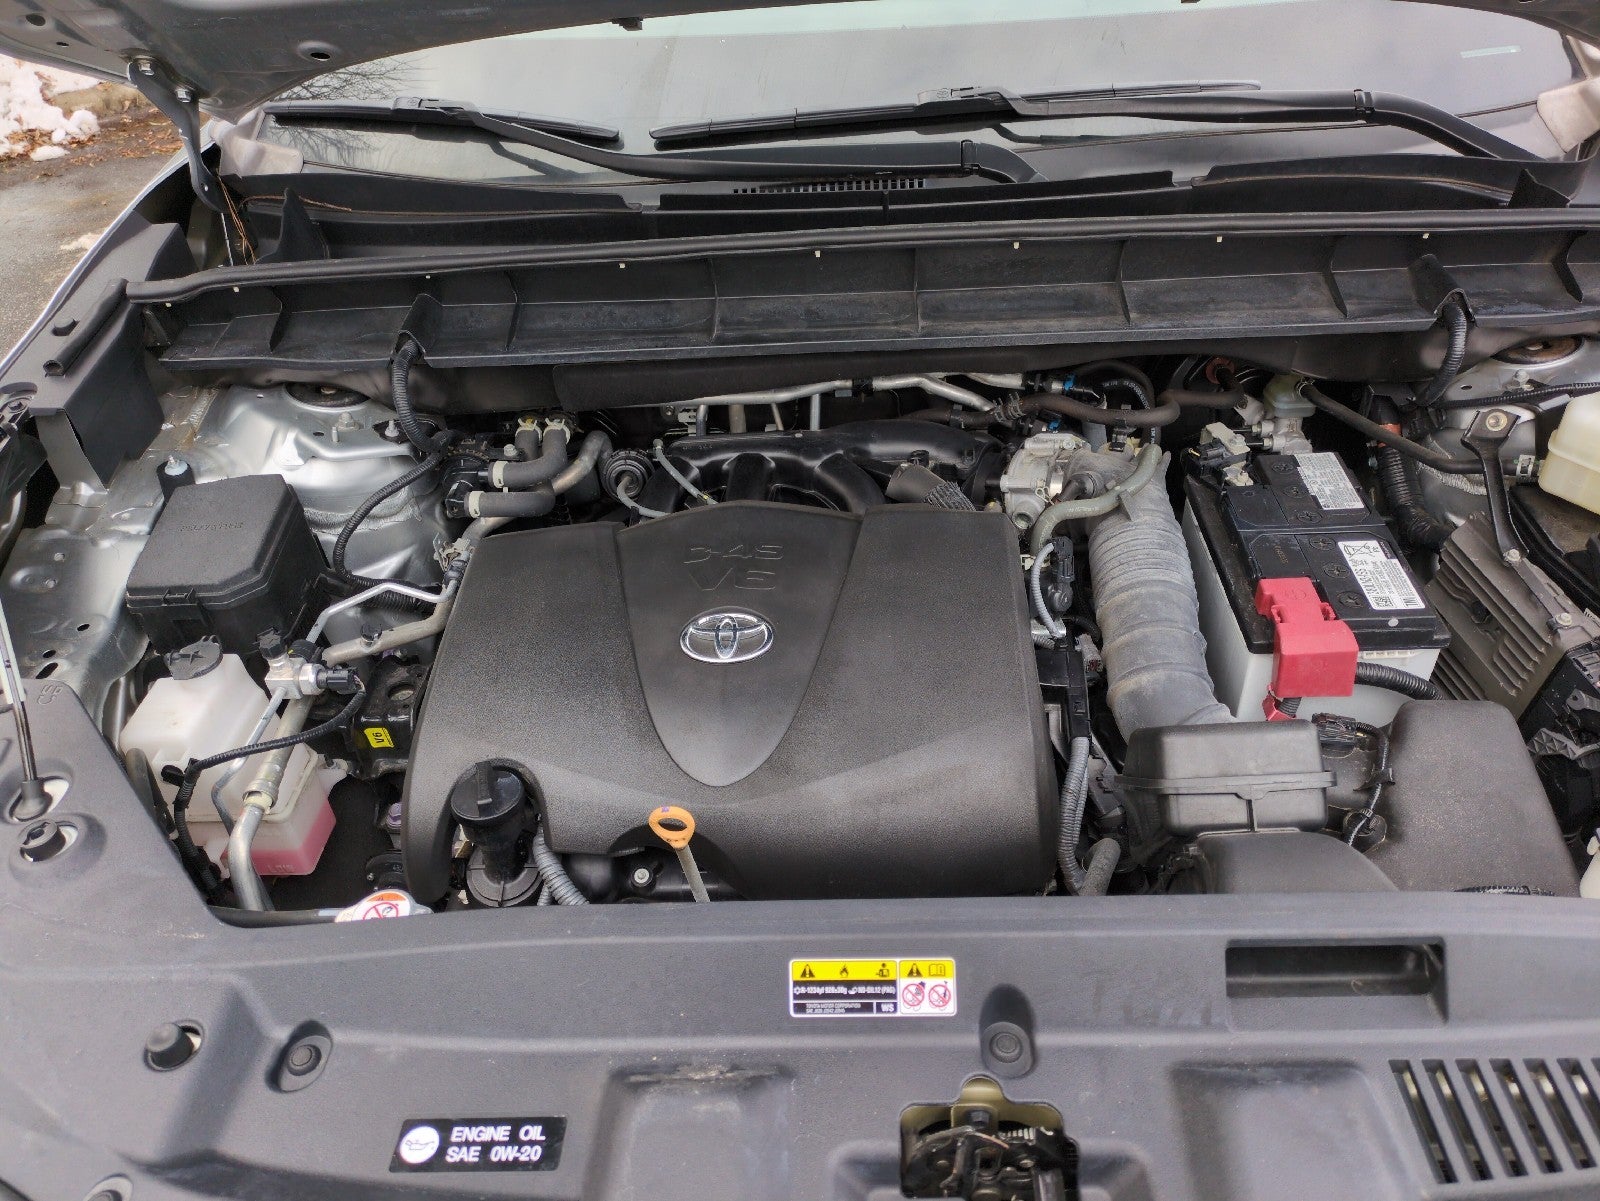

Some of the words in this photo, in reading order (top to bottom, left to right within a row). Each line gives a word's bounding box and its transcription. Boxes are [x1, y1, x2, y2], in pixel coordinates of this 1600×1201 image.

[689, 568, 776, 591] V6
[373, 732, 384, 743] V6
[881, 1003, 894, 1012] WS
[450, 1126, 511, 1142] ENGINE
[518, 1125, 546, 1141] OIL
[445, 1146, 481, 1162] SAE
[490, 1145, 542, 1162] 0W-20
